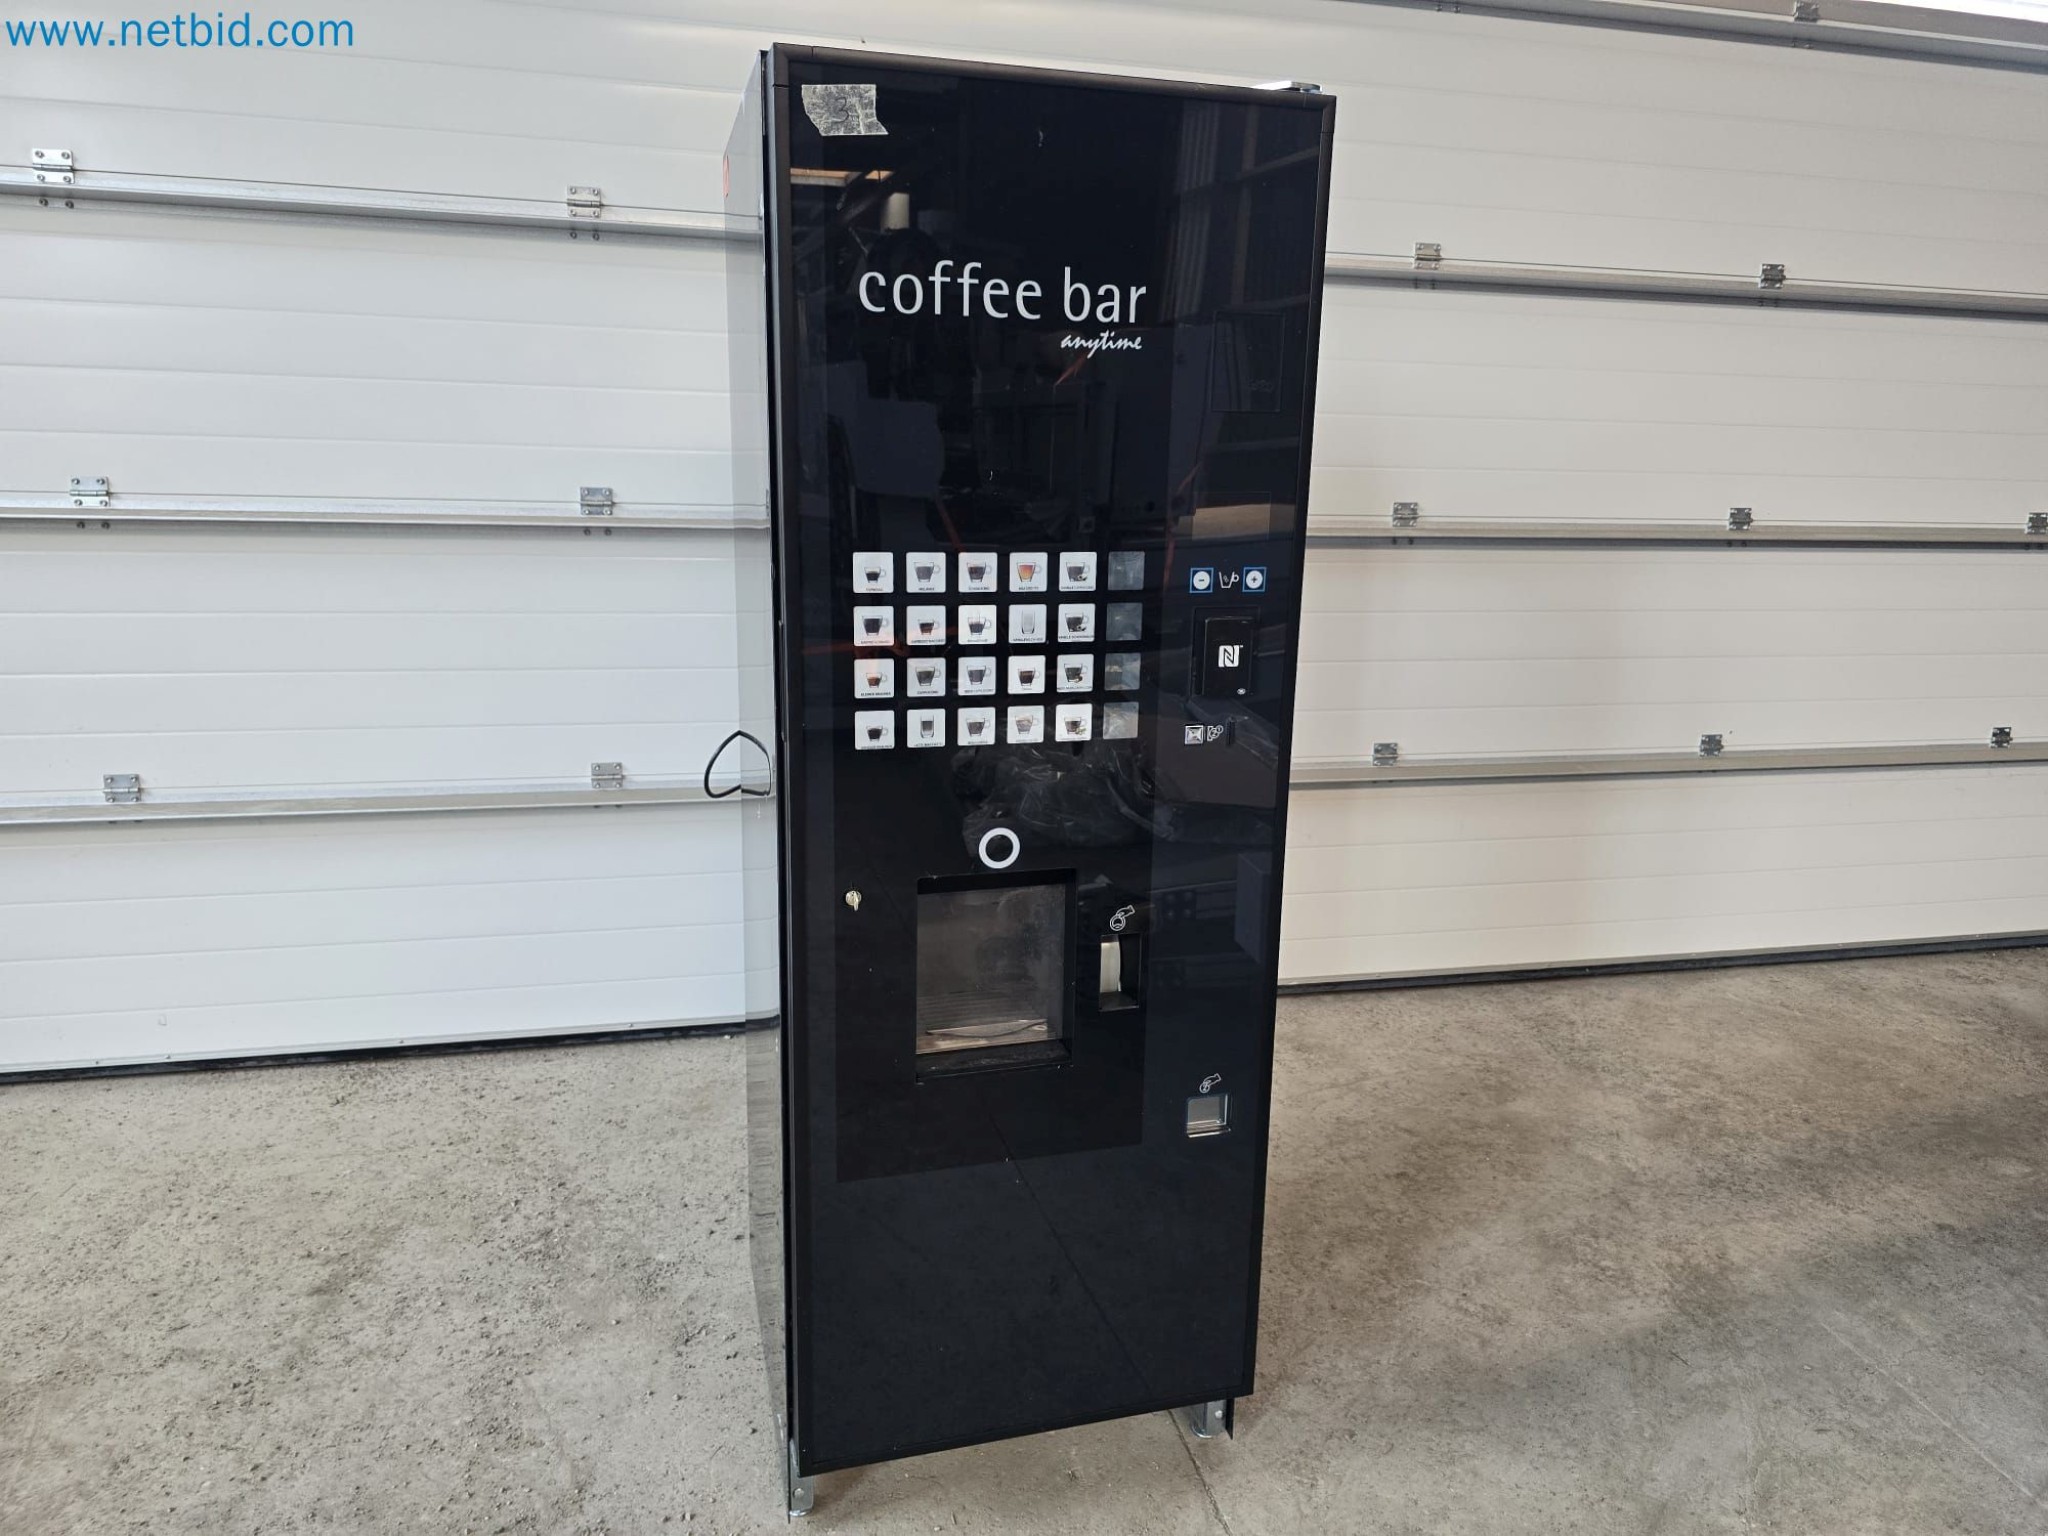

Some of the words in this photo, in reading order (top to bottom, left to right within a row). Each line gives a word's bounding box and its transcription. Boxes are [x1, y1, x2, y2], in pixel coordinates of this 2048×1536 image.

[859, 260, 1042, 320] coffee
[1063, 266, 1146, 323] bar
[1061, 329, 1142, 359] anytime
